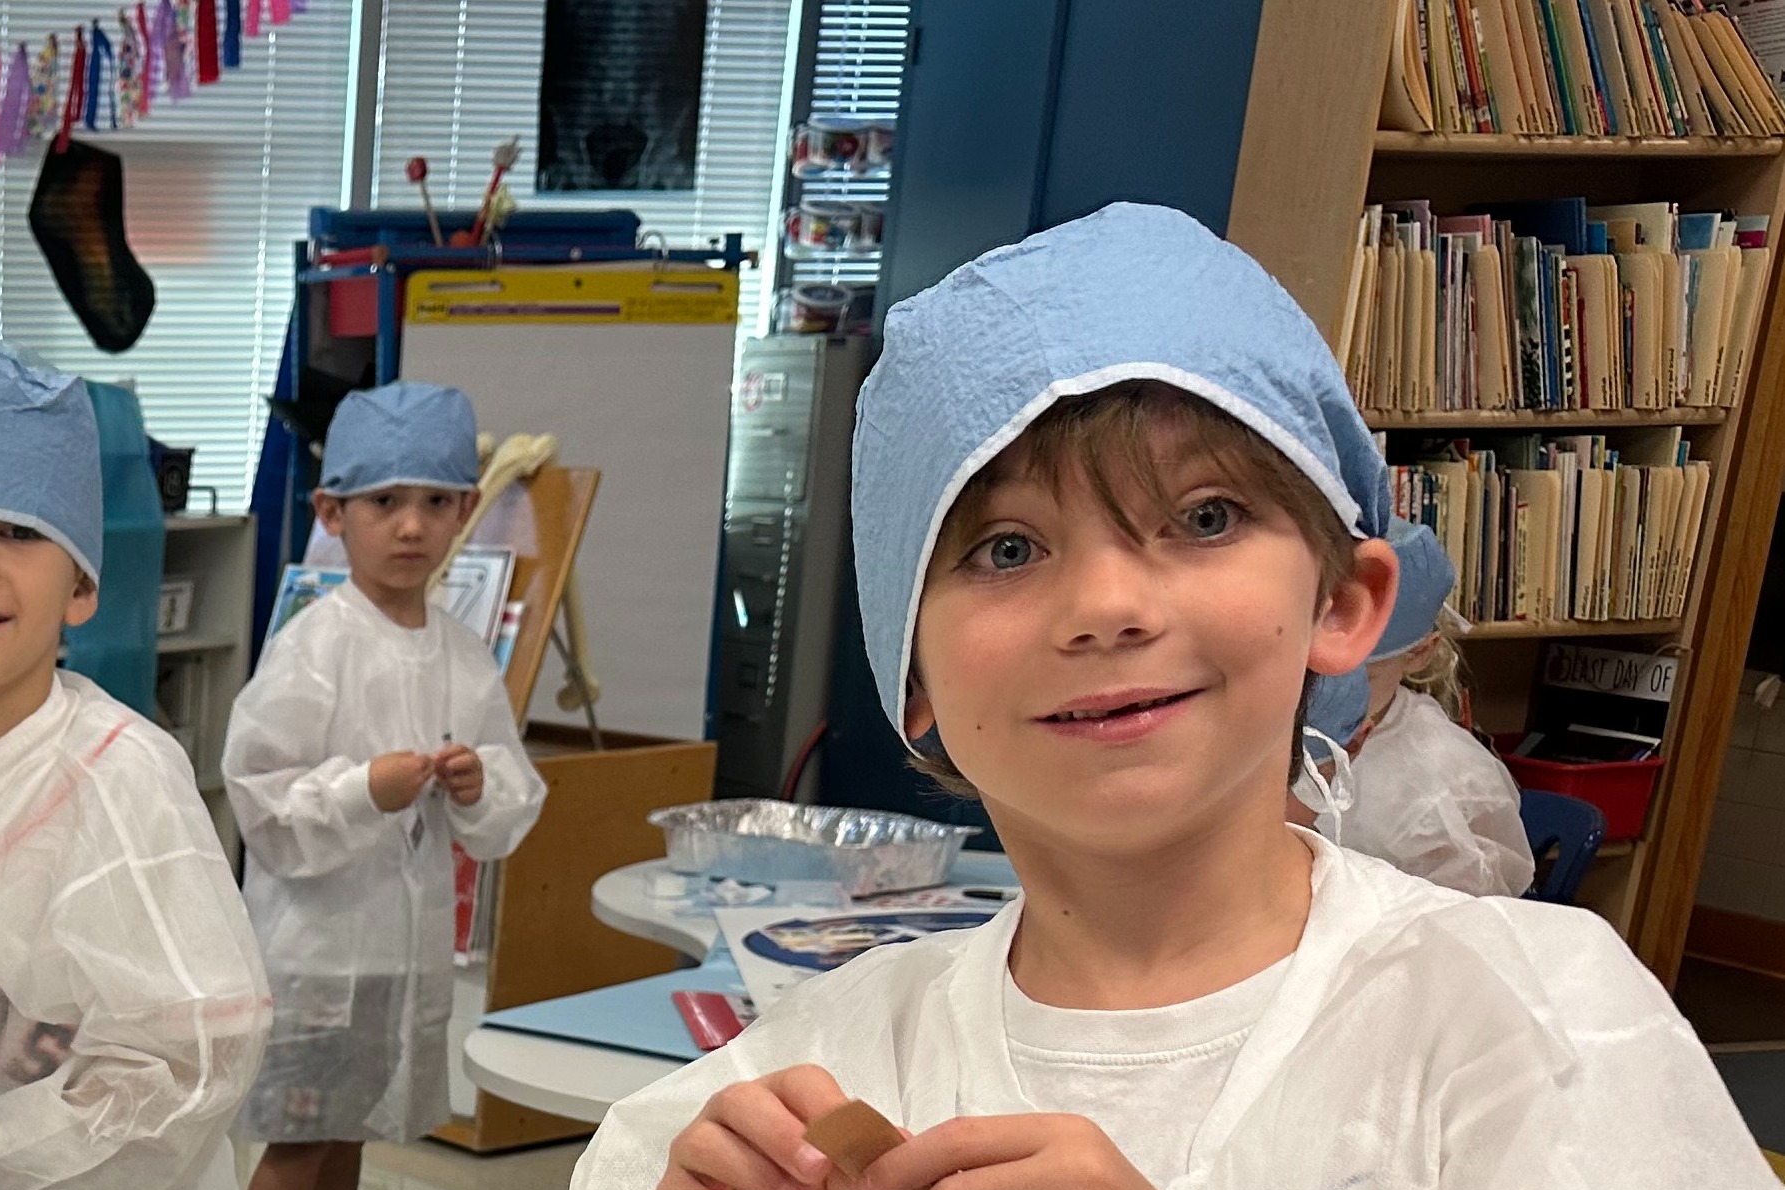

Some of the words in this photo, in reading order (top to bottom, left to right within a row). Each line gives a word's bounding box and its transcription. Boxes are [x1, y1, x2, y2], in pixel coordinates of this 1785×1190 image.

[1571, 650, 1608, 684] LAST
[1613, 659, 1640, 691] DAY
[1650, 664, 1672, 693] OF
